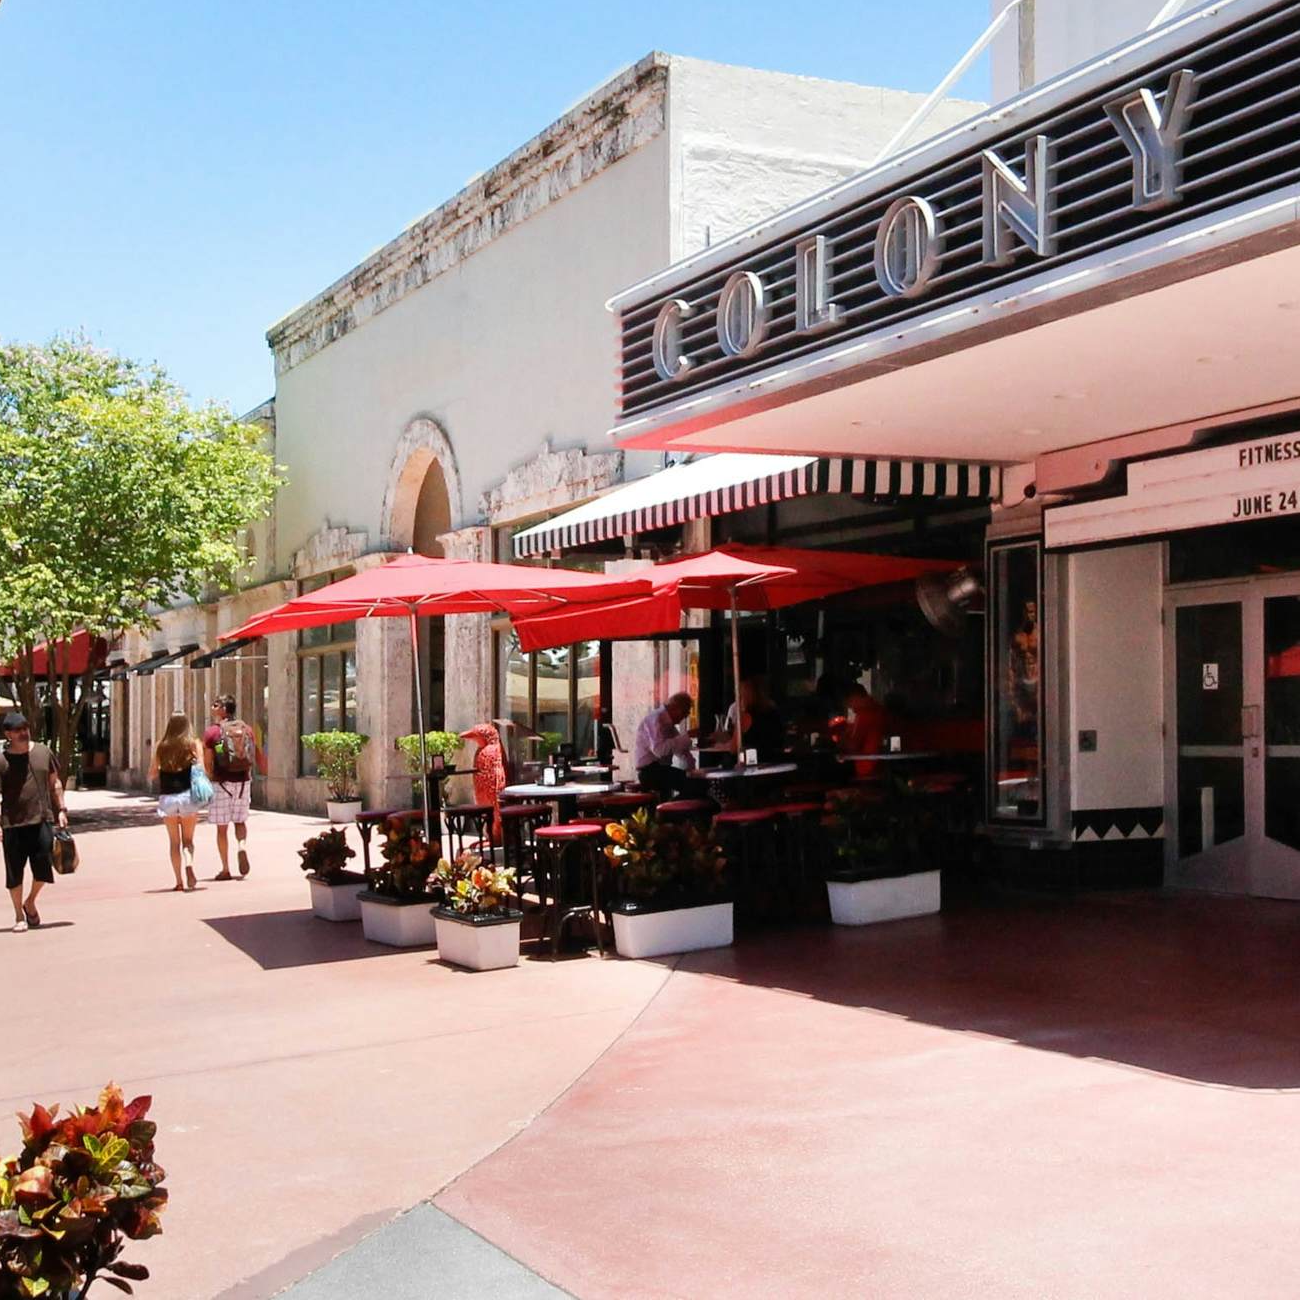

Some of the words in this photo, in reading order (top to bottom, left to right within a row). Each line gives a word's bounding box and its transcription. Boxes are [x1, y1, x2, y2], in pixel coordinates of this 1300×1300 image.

[652, 69, 1197, 381] COLONY
[1233, 495, 1272, 517] JUNE
[1279, 491, 1297, 510] 24
